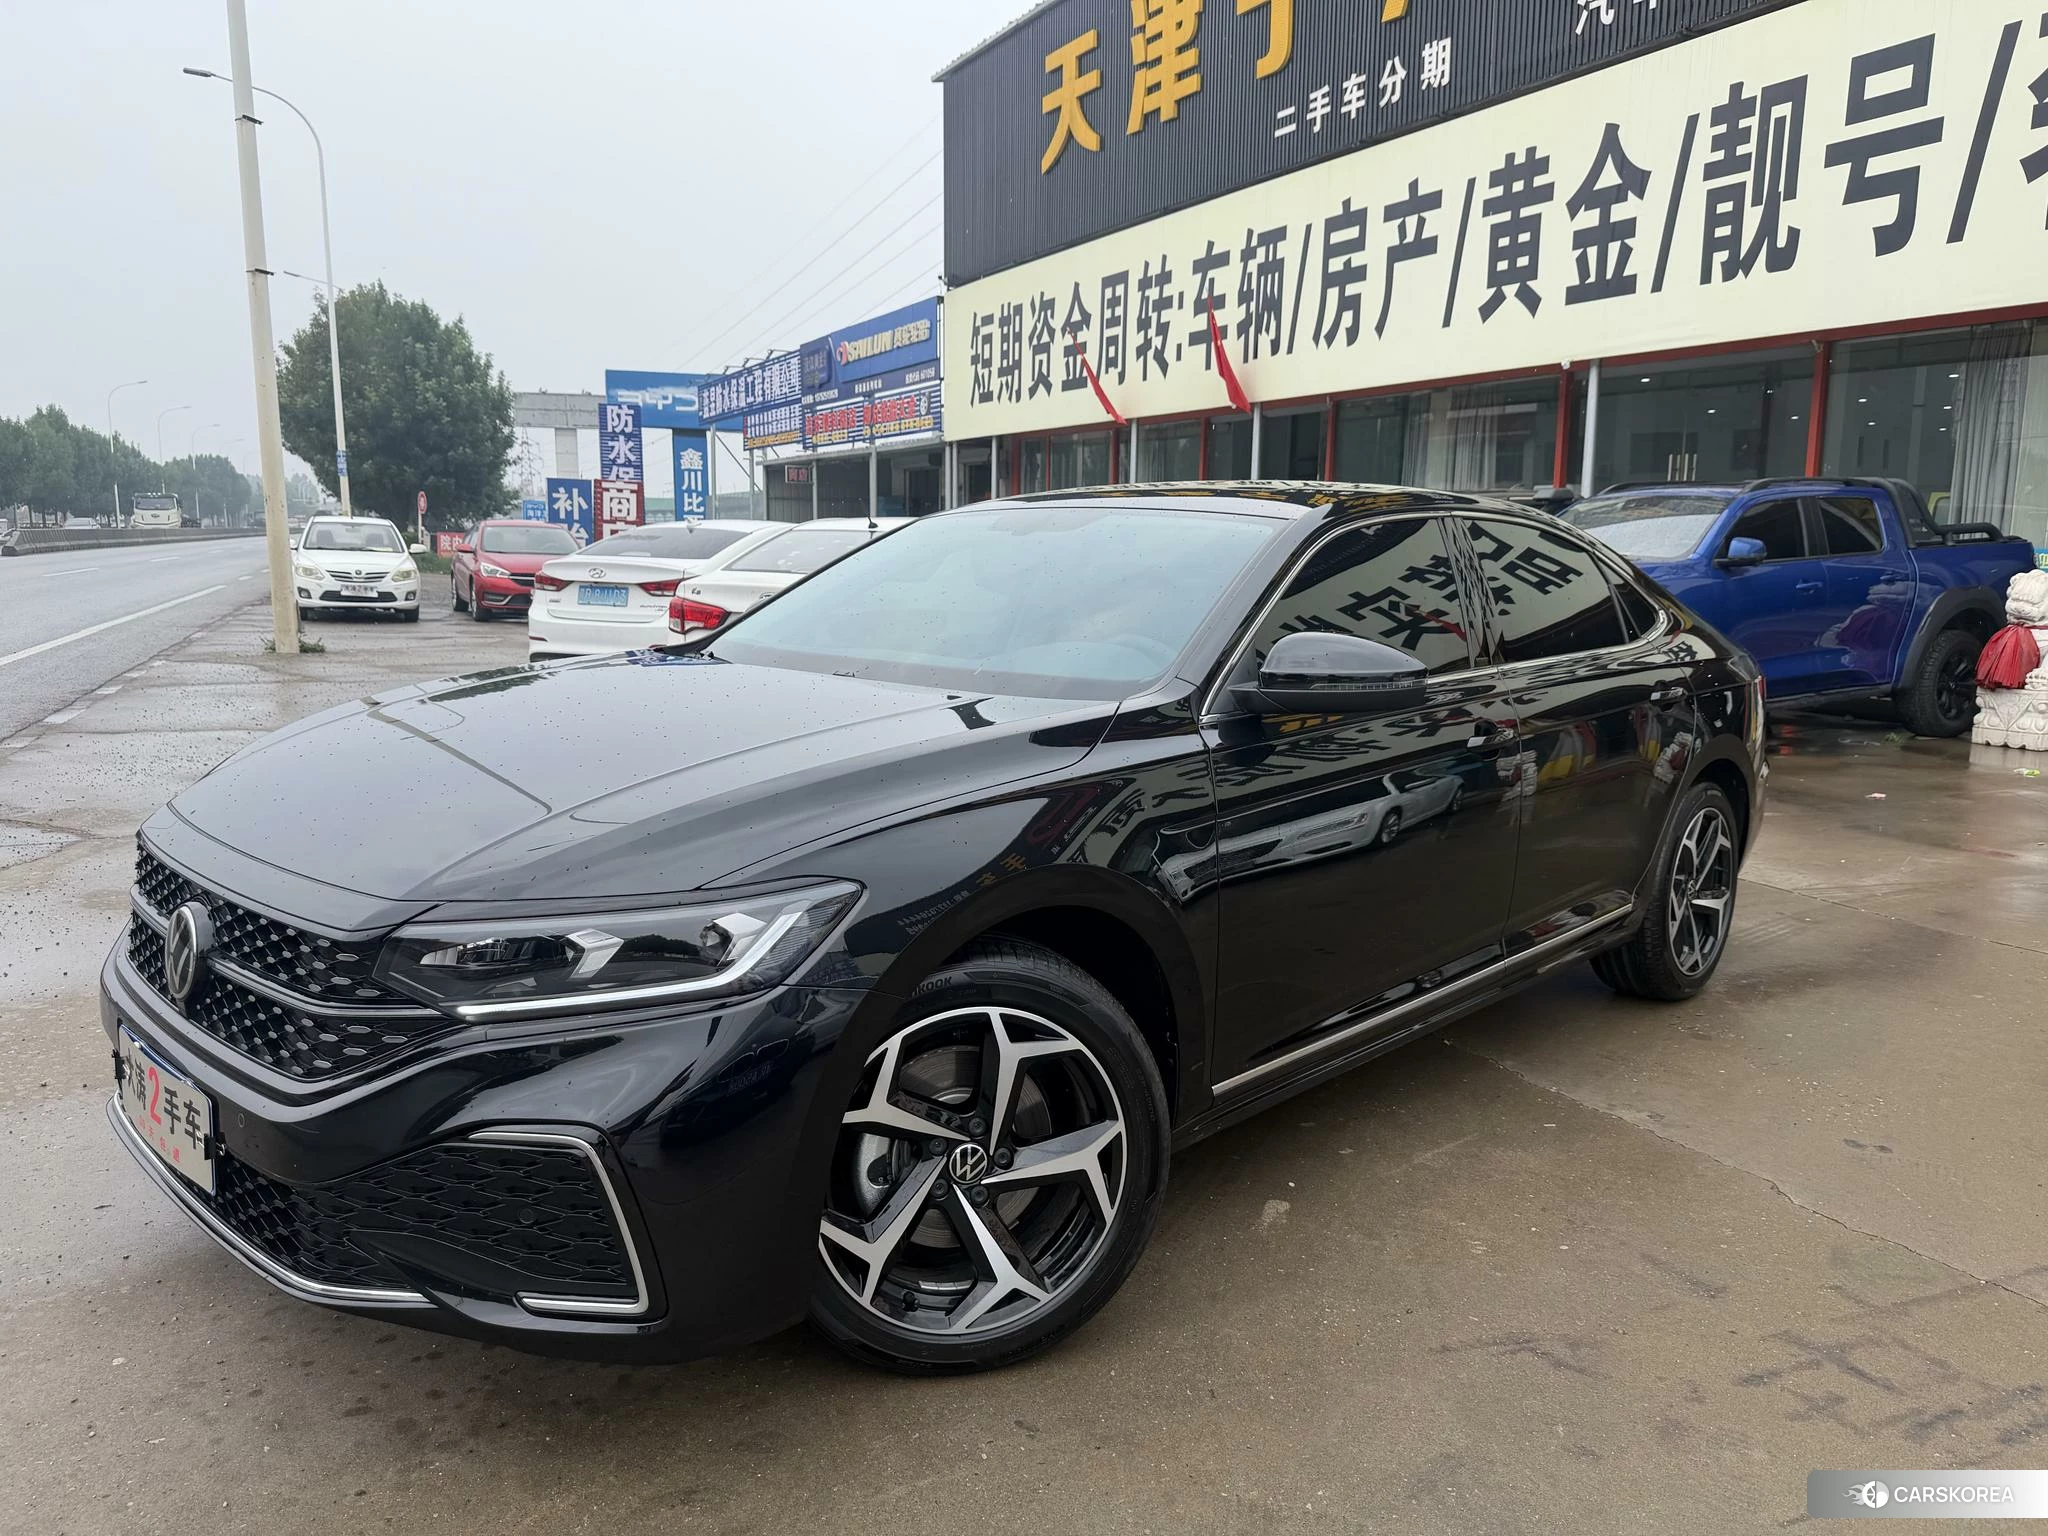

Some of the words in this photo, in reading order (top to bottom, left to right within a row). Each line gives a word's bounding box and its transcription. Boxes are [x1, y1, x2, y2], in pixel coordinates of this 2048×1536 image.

[970, 13, 2048, 407] 短期资金周转:车辆/房产/黄金/靓号/
[1273, 37, 1452, 138] 二手车分期
